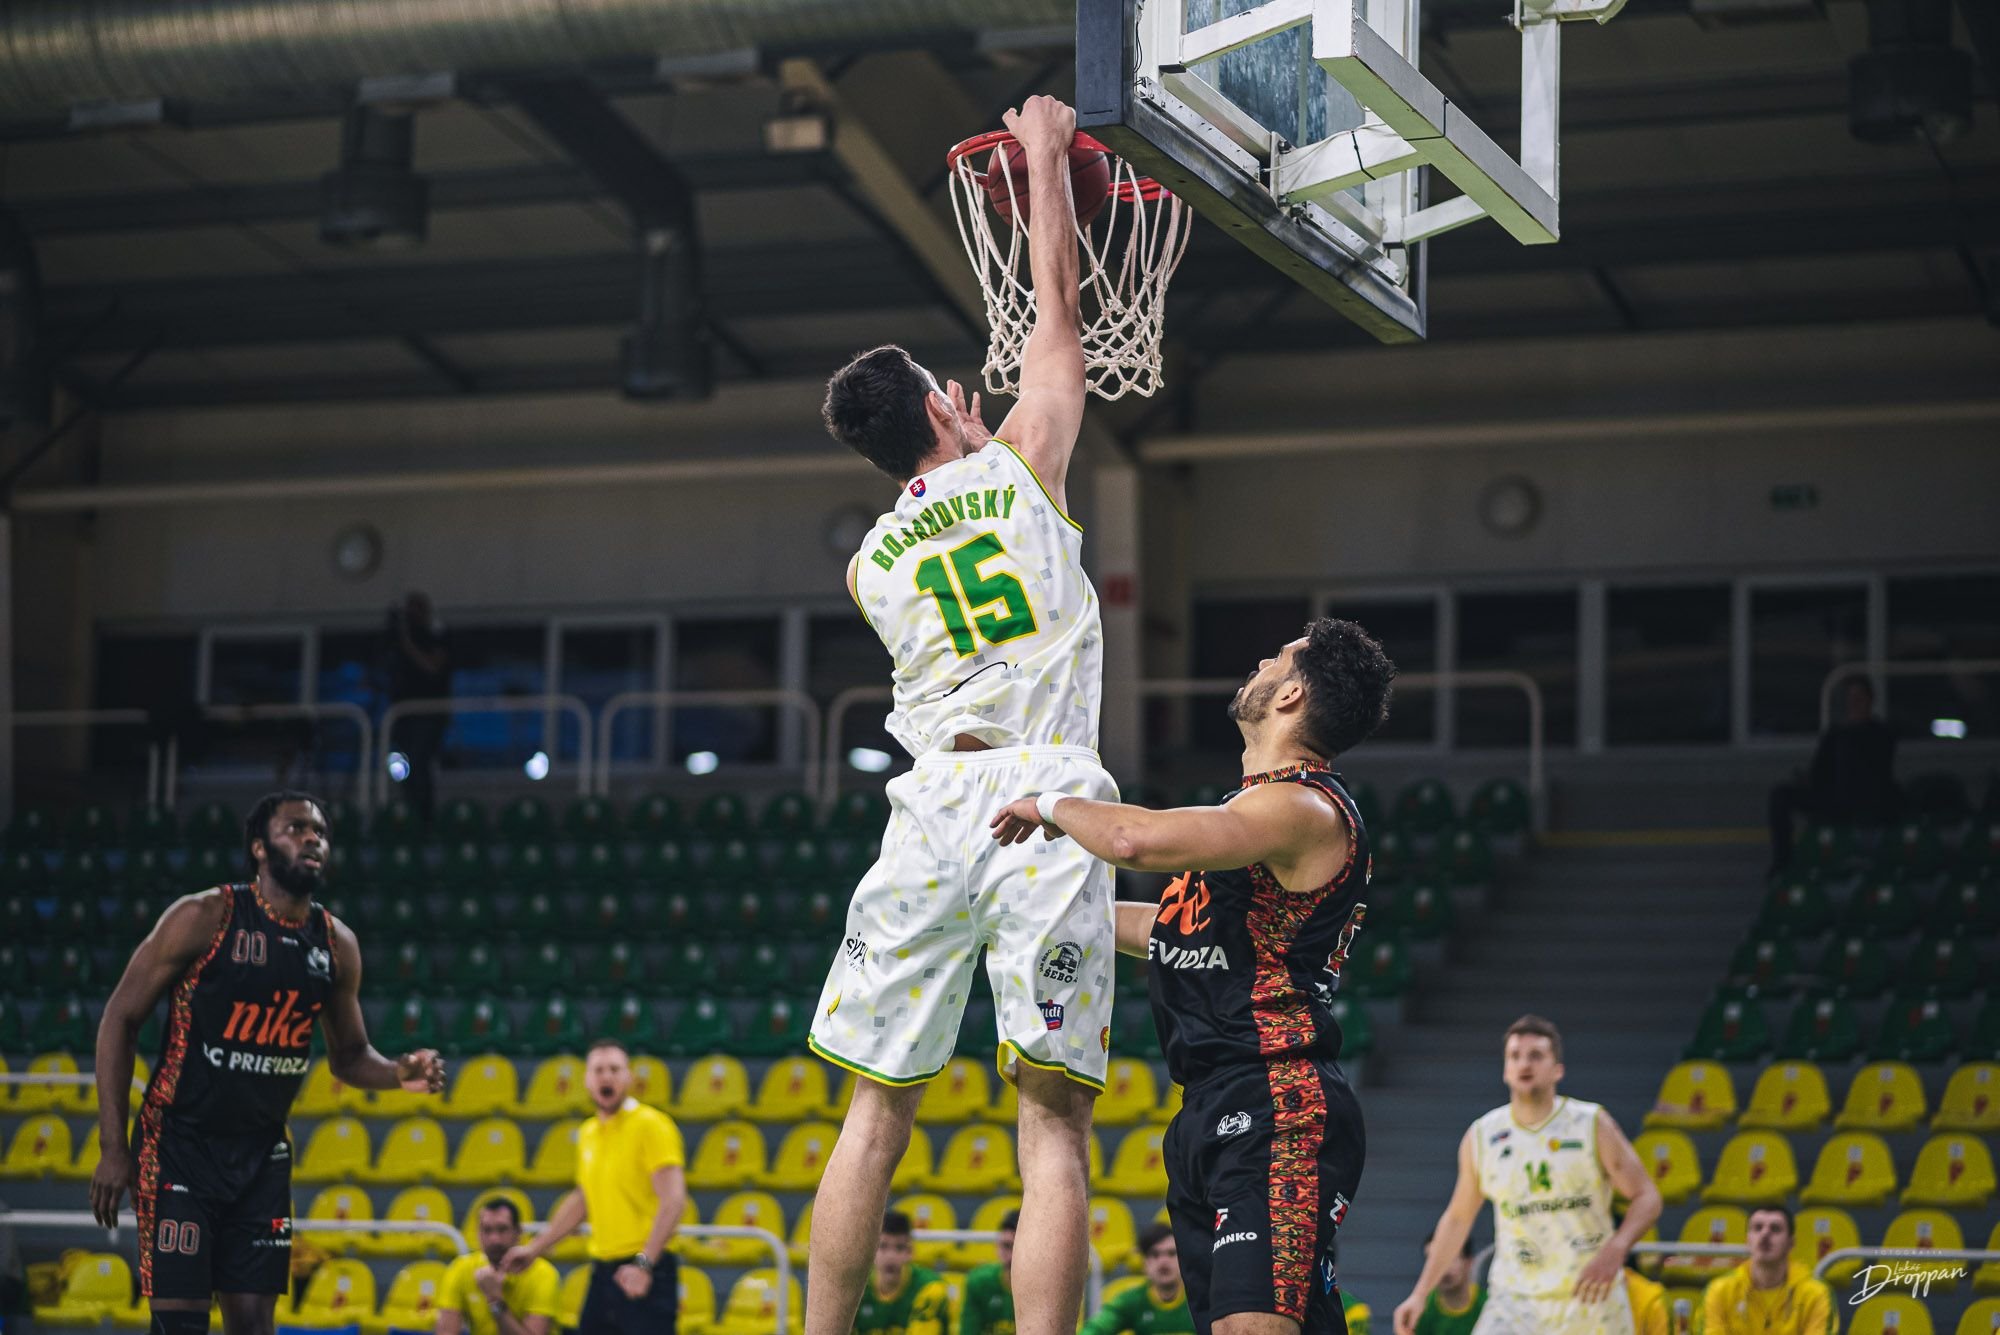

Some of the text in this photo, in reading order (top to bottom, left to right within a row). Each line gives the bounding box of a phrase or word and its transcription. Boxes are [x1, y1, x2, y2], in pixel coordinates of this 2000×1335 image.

[912, 530, 1039, 660] 15
[232, 929, 268, 965] 00
[1043, 966, 1073, 983] ŠEBO
[1525, 1160, 1551, 1193] 14
[158, 1219, 200, 1255] 00
